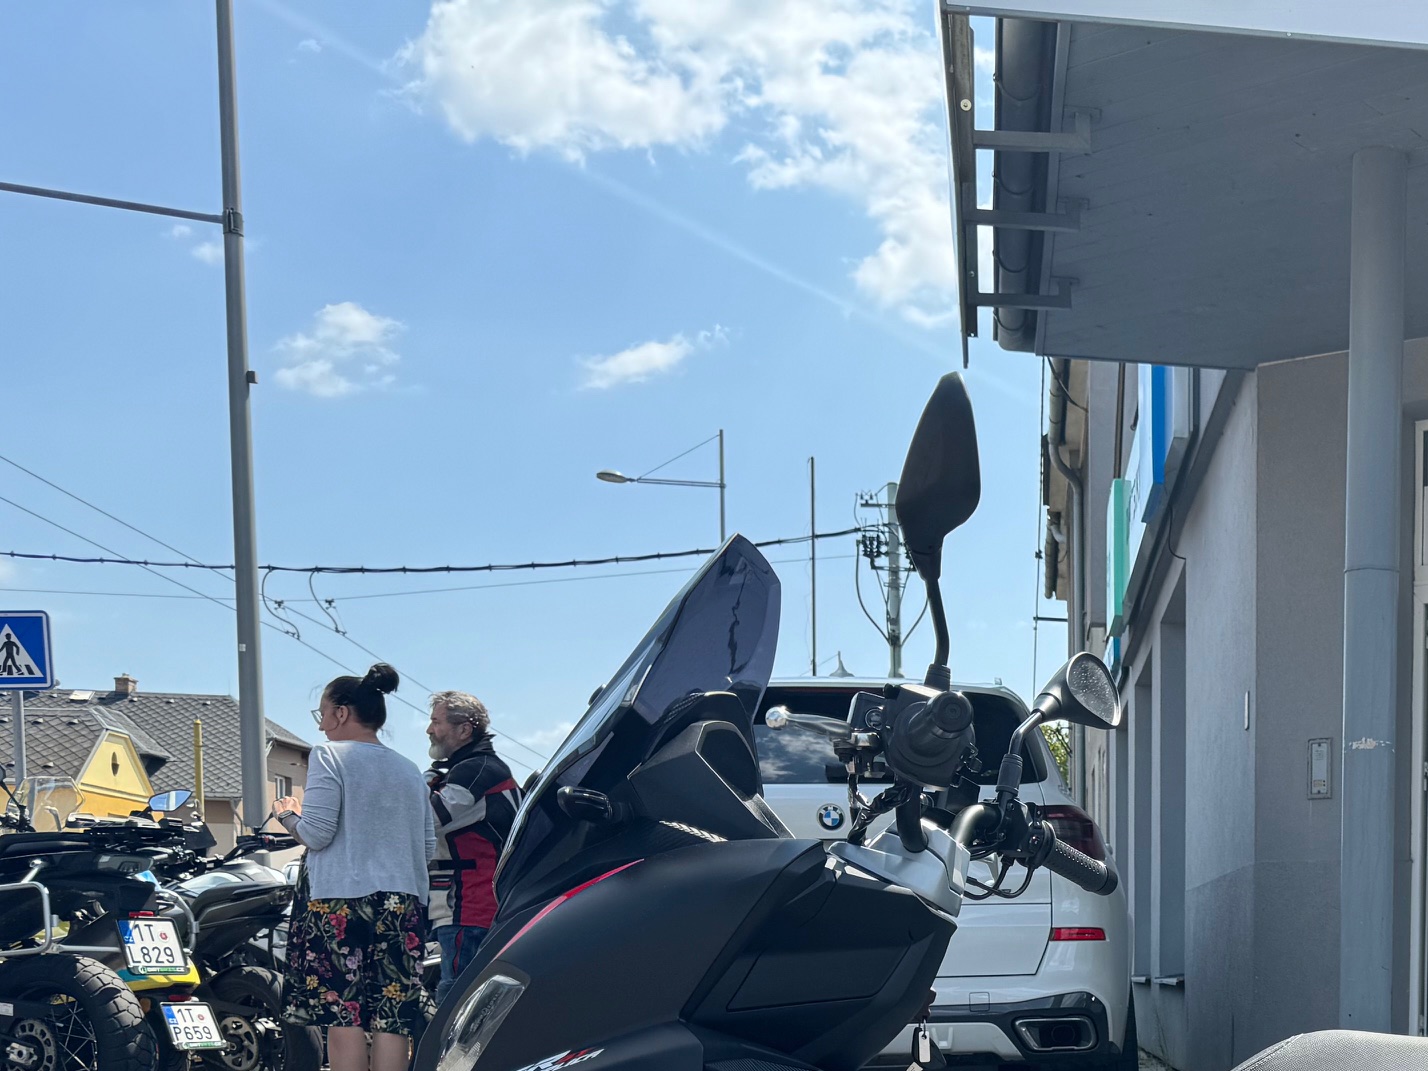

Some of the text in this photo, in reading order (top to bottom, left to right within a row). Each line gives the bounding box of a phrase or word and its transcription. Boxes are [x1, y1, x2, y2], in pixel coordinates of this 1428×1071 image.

[134, 923, 155, 942] 1T
[127, 945, 176, 964] L829
[176, 1007, 195, 1024] 1T
[172, 1025, 213, 1041] P659
